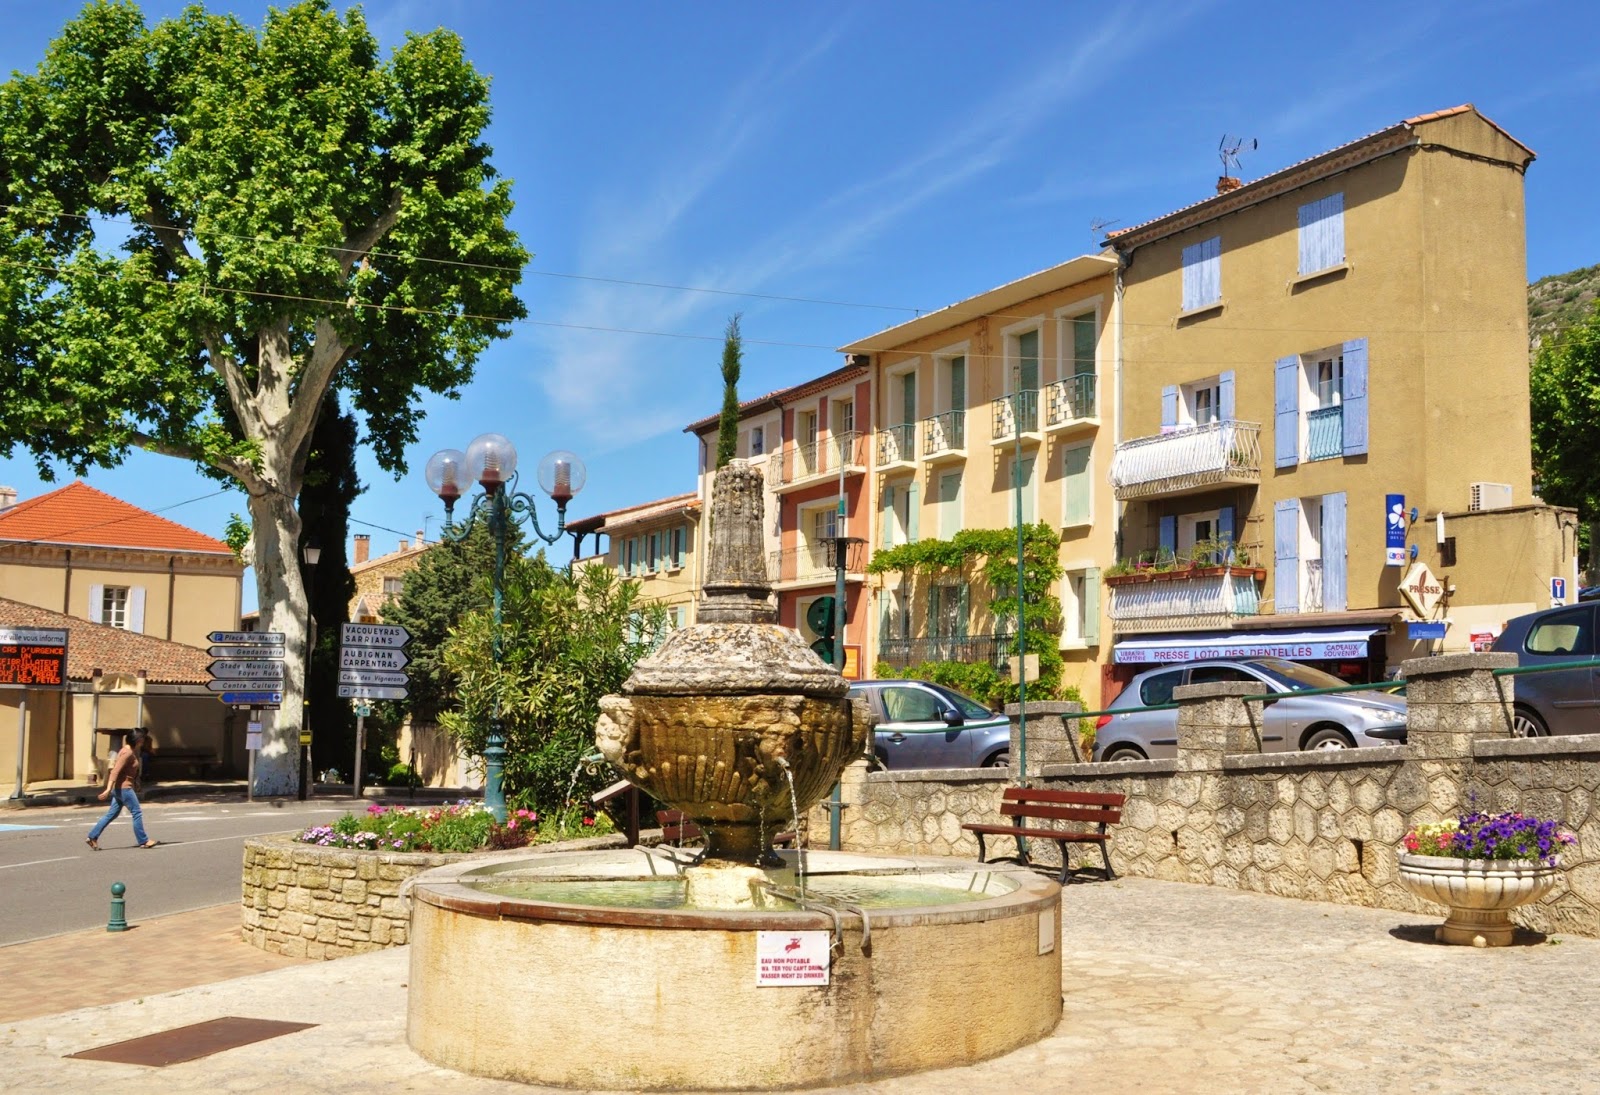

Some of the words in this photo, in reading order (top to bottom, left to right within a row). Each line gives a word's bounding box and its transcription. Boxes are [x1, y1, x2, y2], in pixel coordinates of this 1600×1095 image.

[1409, 585, 1440, 594] PRESSE
[345, 626, 400, 636] VACQUEYRAS
[9, 633, 22, 641] ville
[39, 634, 64, 643] informe
[345, 635, 393, 645] SARRIANS
[21, 647, 64, 655] D'URGENCE
[344, 650, 393, 659] AUBIGNAN
[1154, 651, 1190, 660] PRESSE
[1194, 650, 1220, 660] LOTO
[1224, 649, 1245, 657] DES
[1249, 647, 1313, 657] DENTELLES
[245, 663, 283, 671] Municipal
[343, 659, 398, 668] CARPENTRAS
[10, 664, 58, 673] DISPONIBLE
[374, 674, 404, 683] Vignerons
